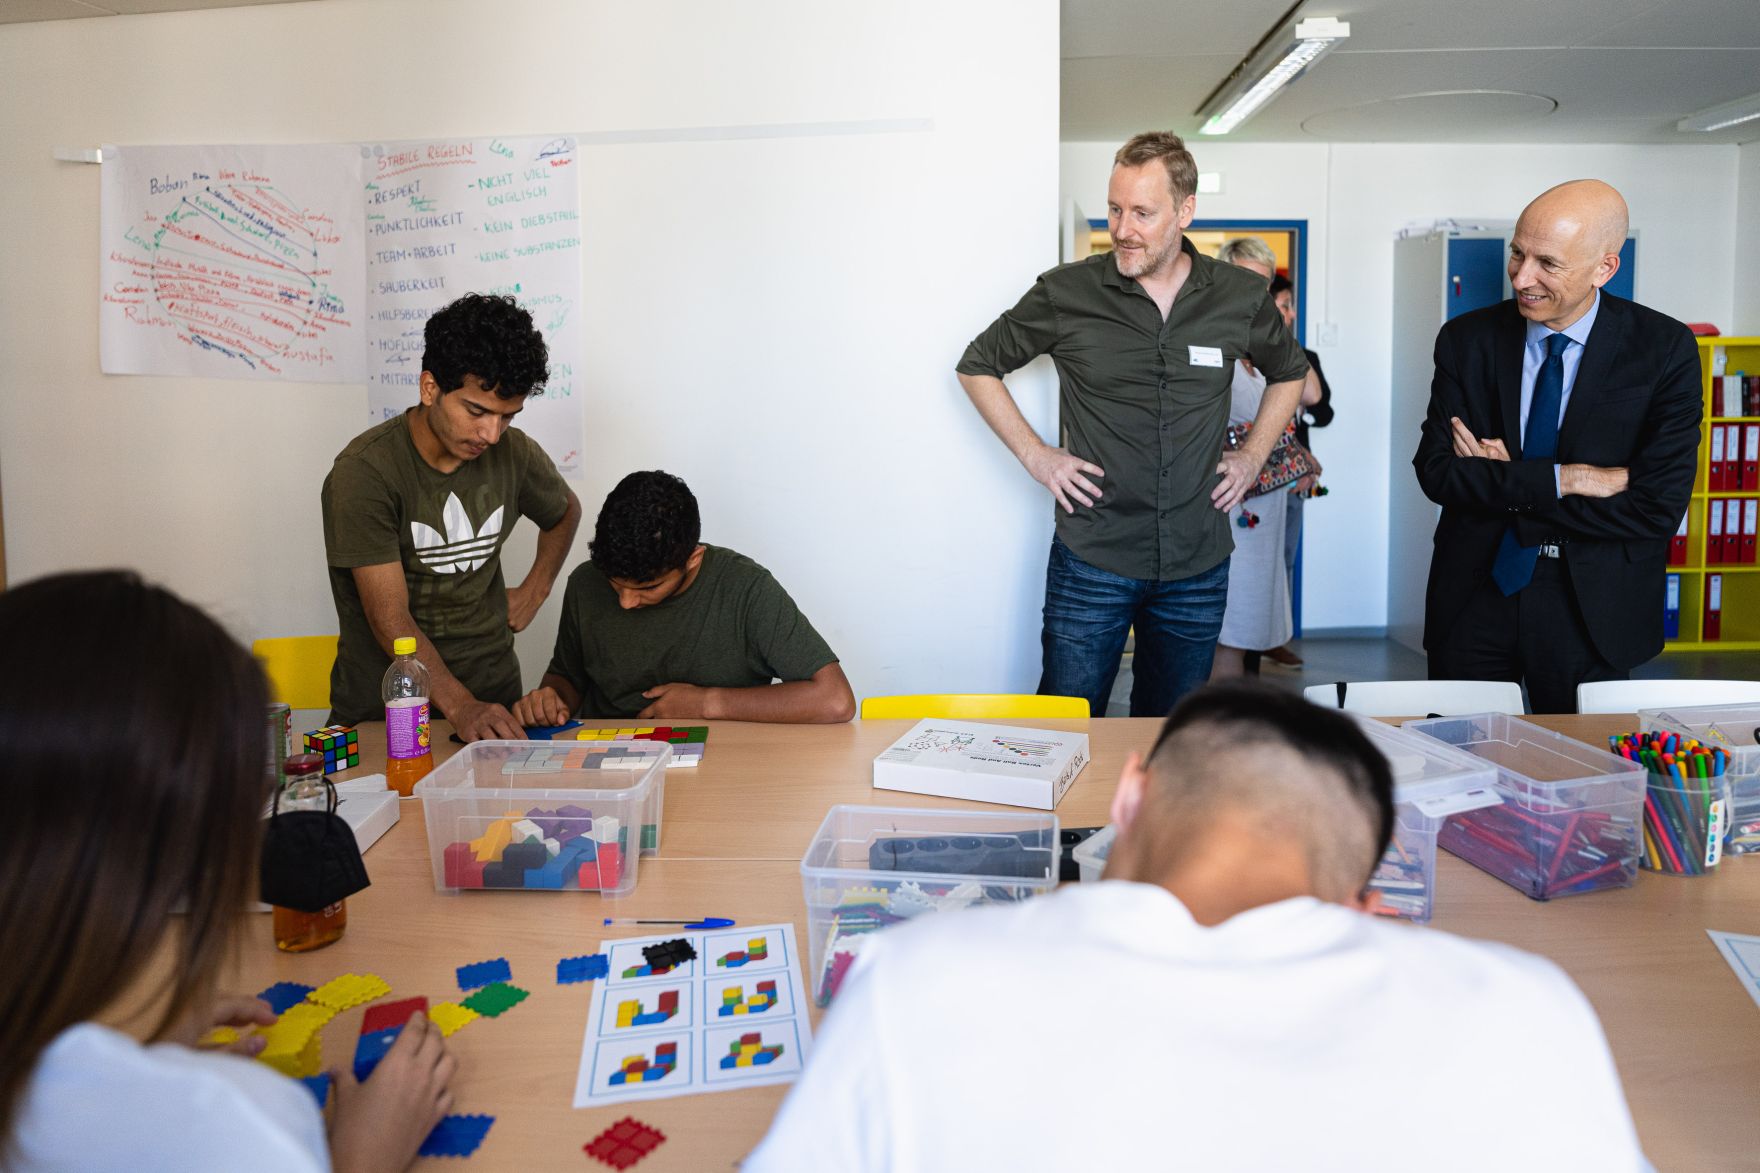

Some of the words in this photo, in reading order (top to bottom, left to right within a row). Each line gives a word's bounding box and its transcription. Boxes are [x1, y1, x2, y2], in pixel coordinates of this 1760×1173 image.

[427, 142, 473, 160] REGELN
[374, 180, 421, 204] RESPEKT
[379, 276, 447, 295] SAUBERKEIT
